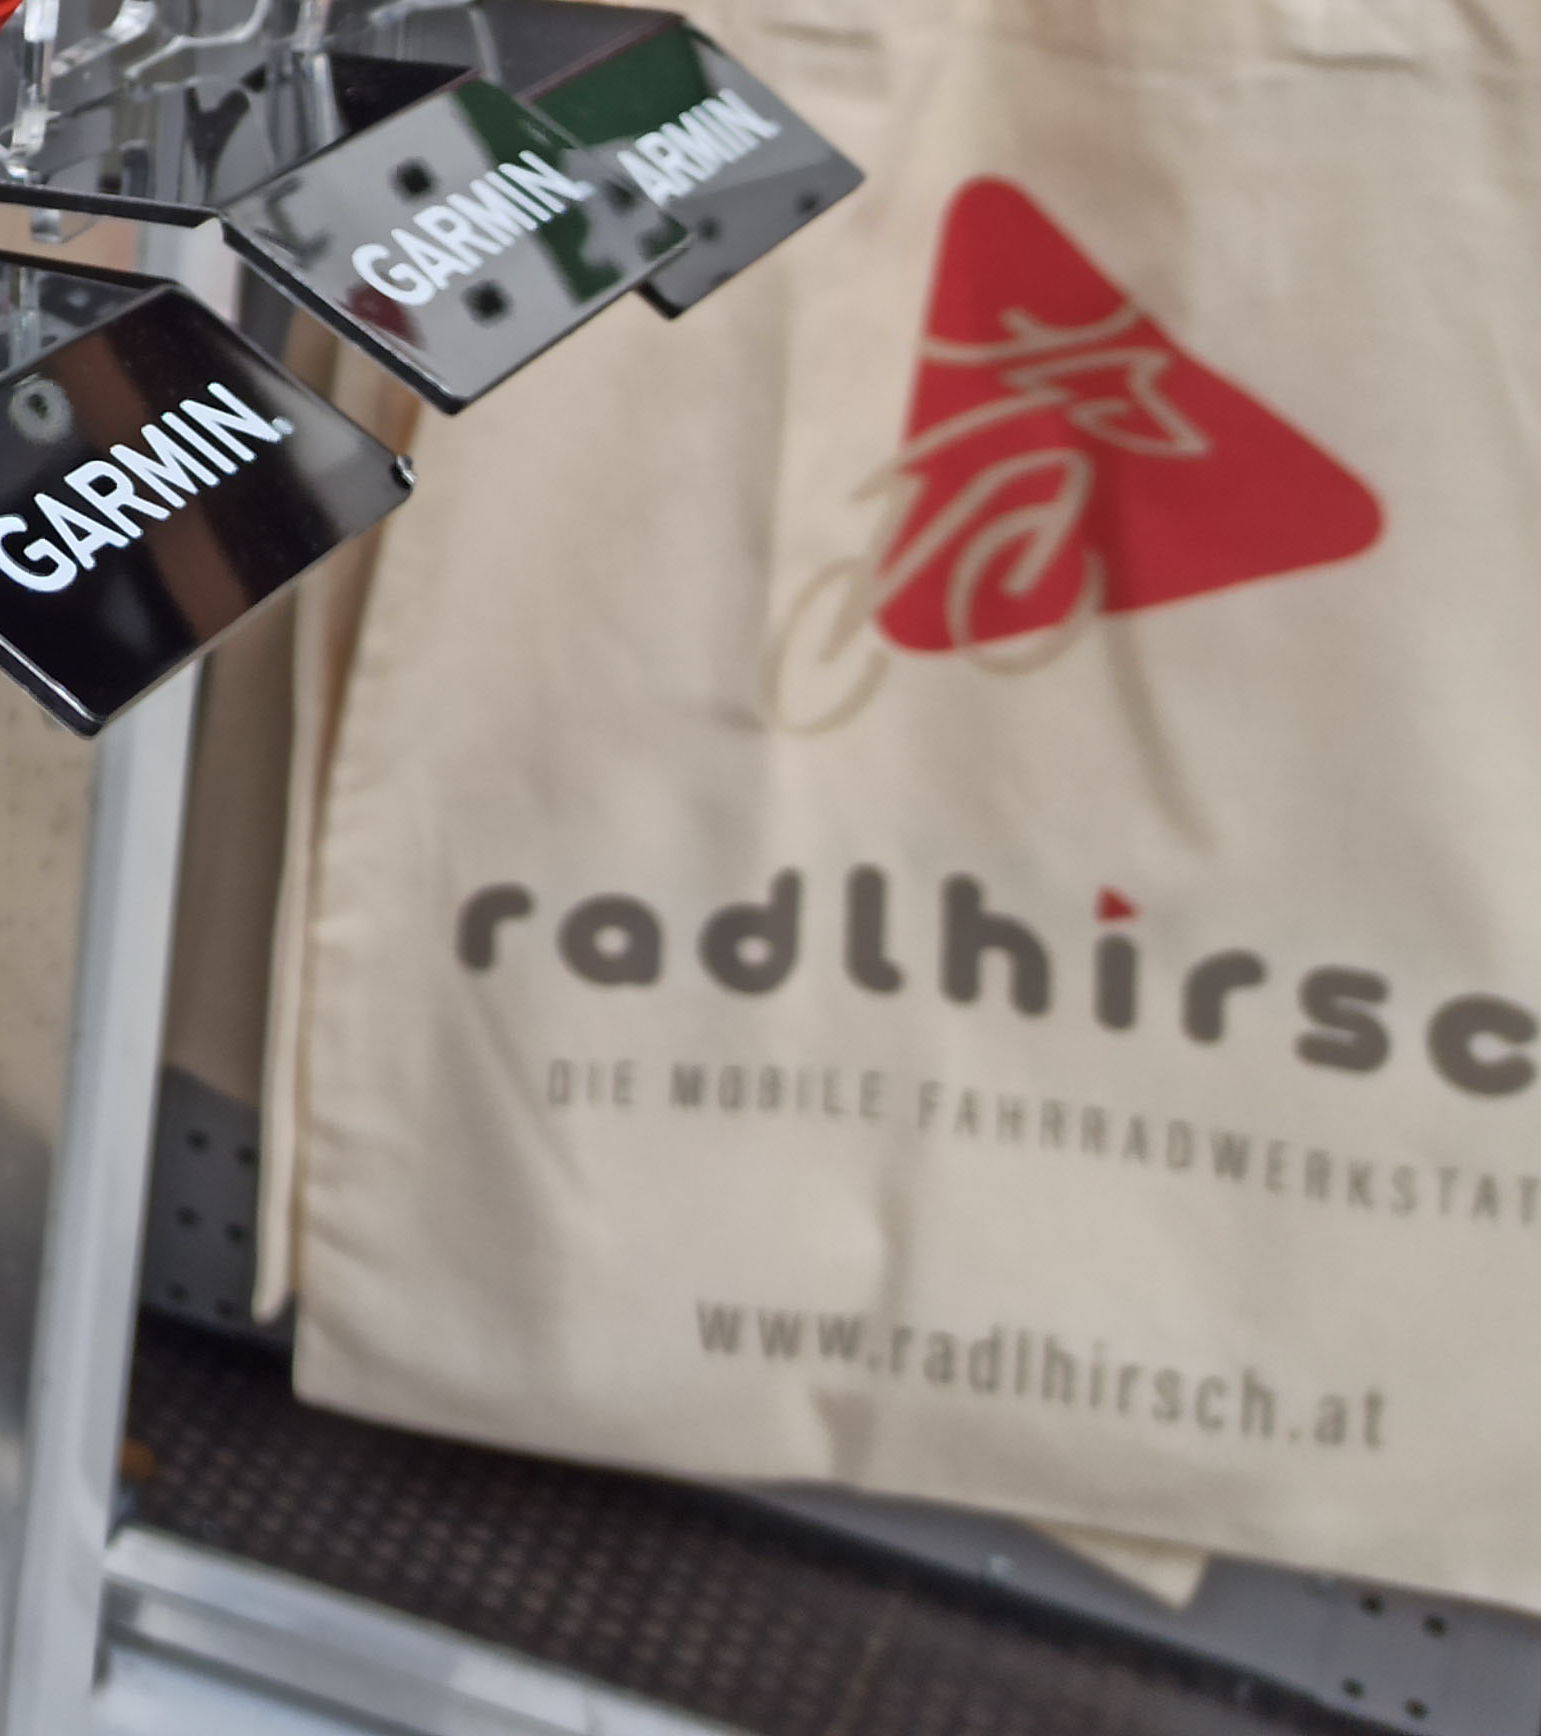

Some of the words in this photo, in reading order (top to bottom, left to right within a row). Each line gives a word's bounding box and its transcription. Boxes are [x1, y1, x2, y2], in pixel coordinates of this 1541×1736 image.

[547, 1059, 635, 1108] DIE
[670, 1063, 887, 1121] MOBILE
[696, 1299, 1383, 1451] www.radlhirsch.at
